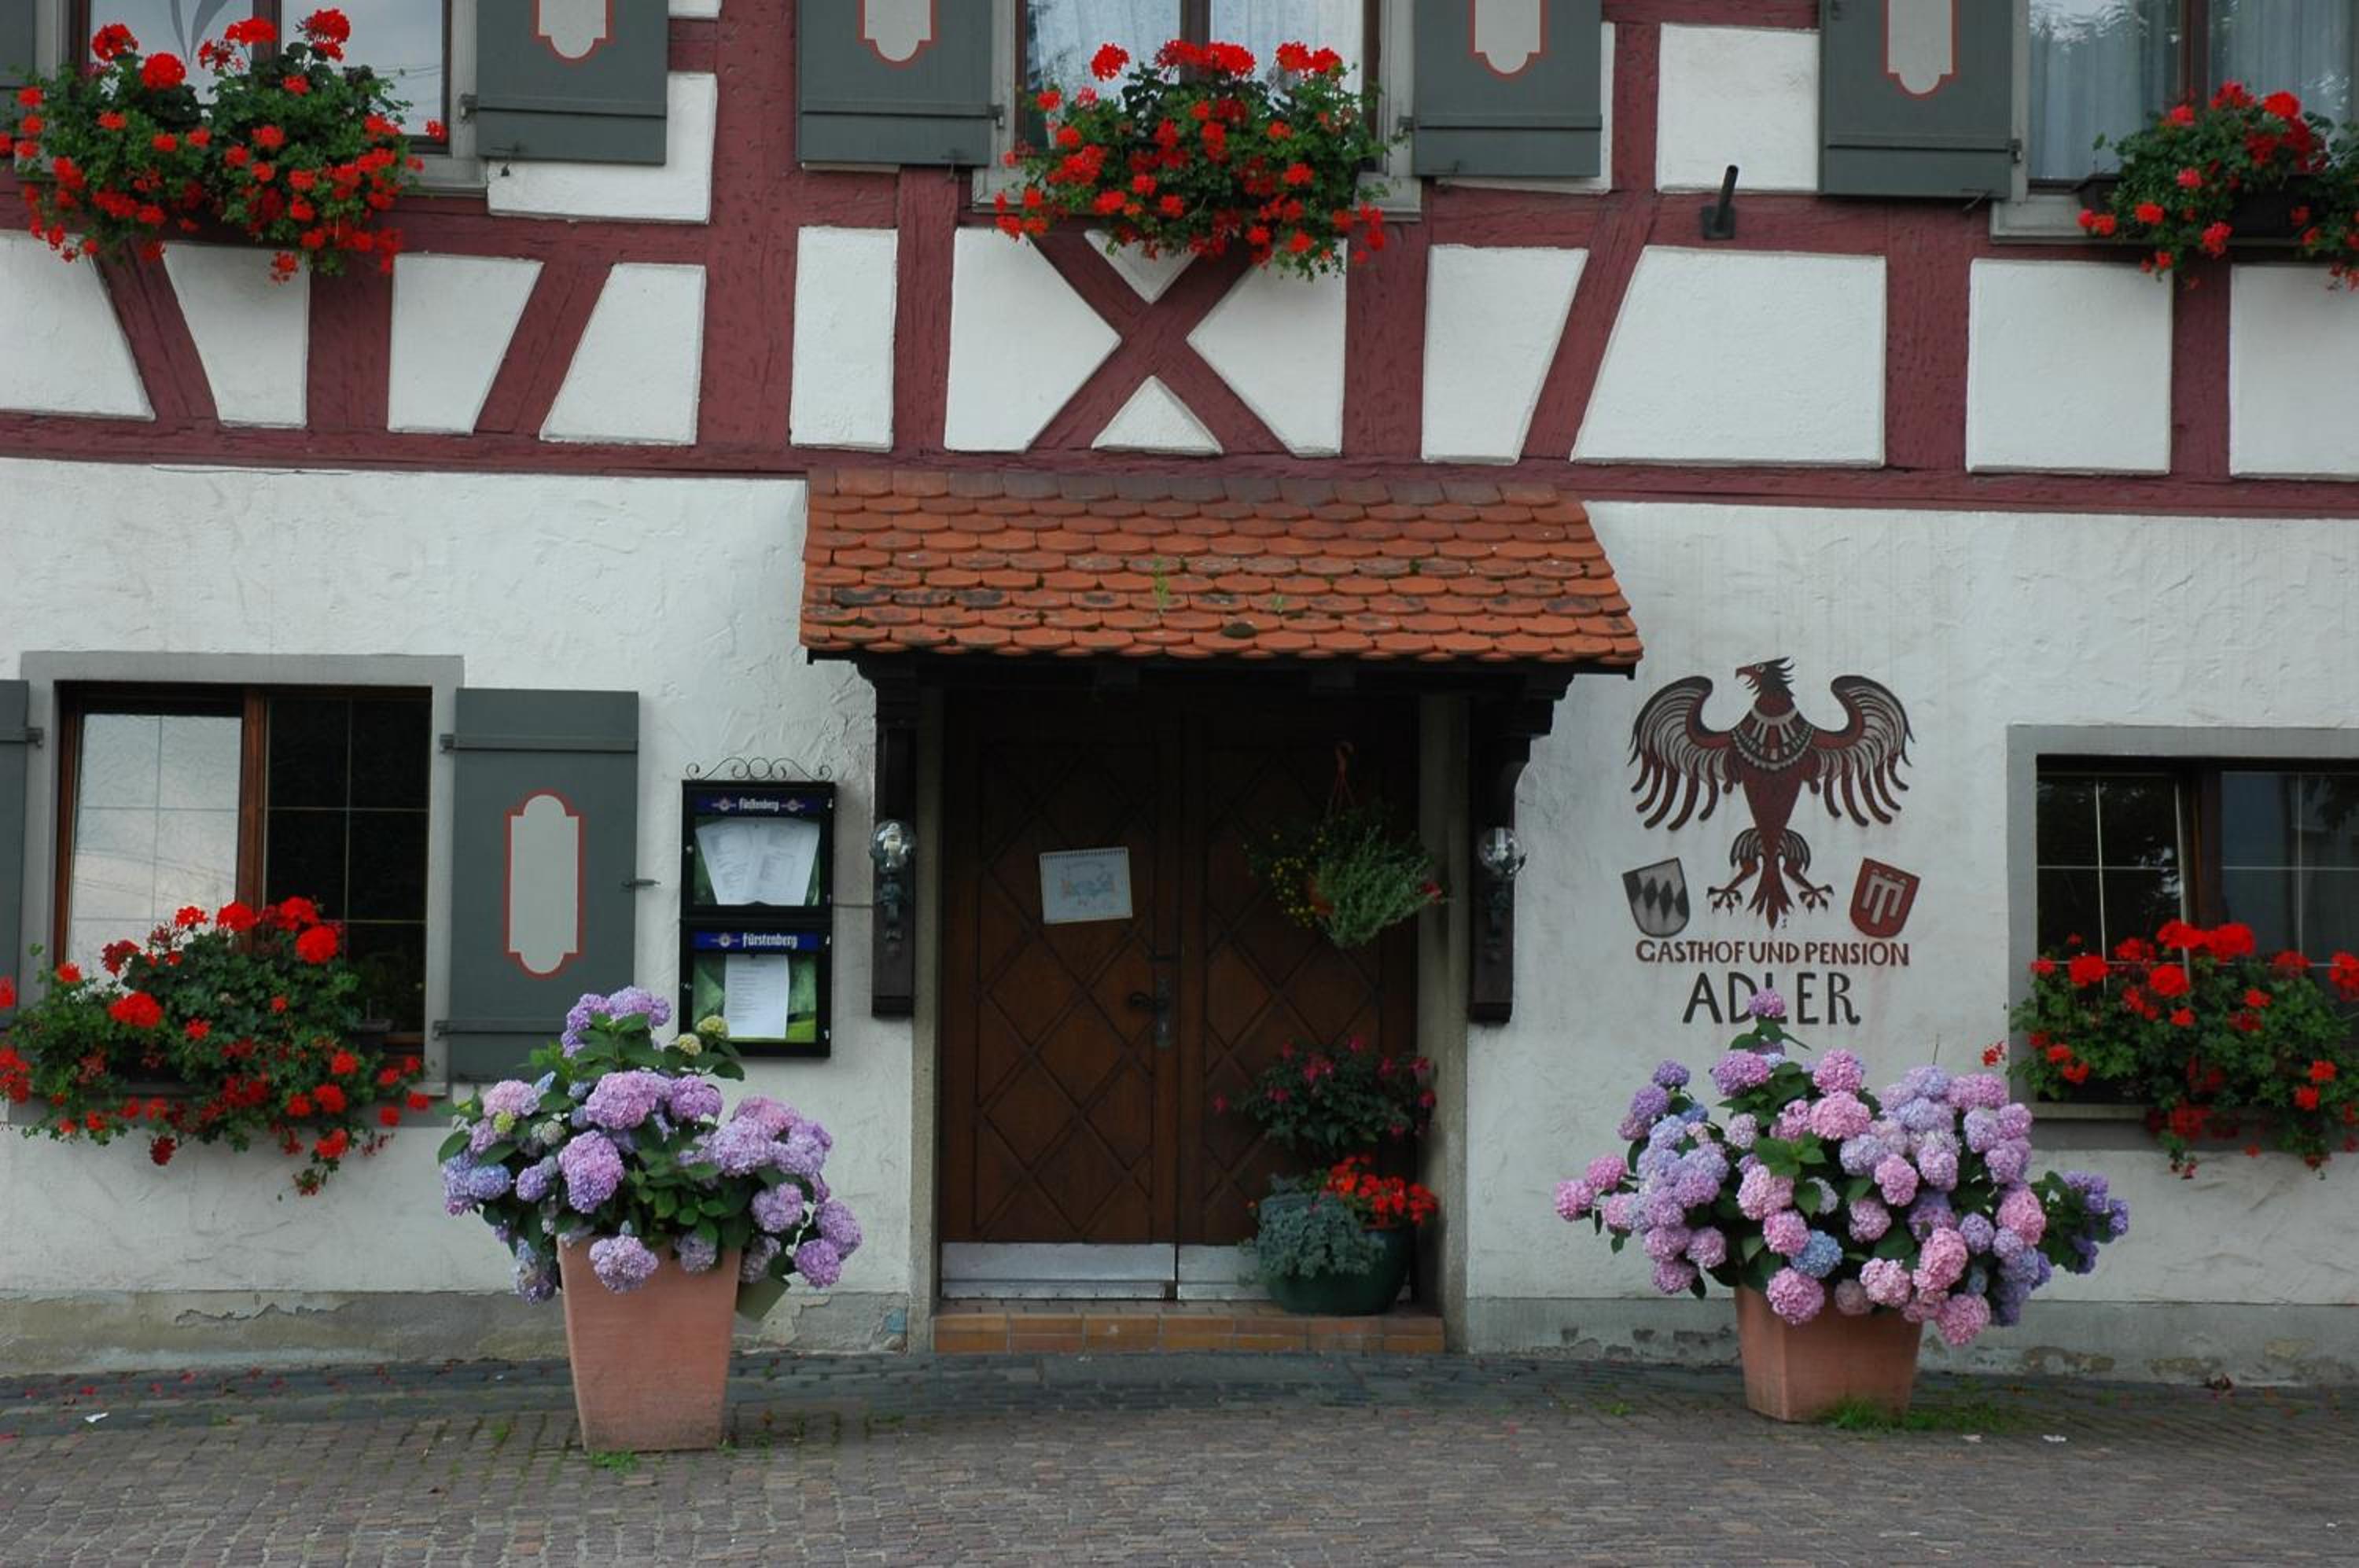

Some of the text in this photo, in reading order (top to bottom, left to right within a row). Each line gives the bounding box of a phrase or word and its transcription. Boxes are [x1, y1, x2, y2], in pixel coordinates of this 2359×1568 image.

[1636, 940, 1909, 966] GASTHOF UND PENSION
